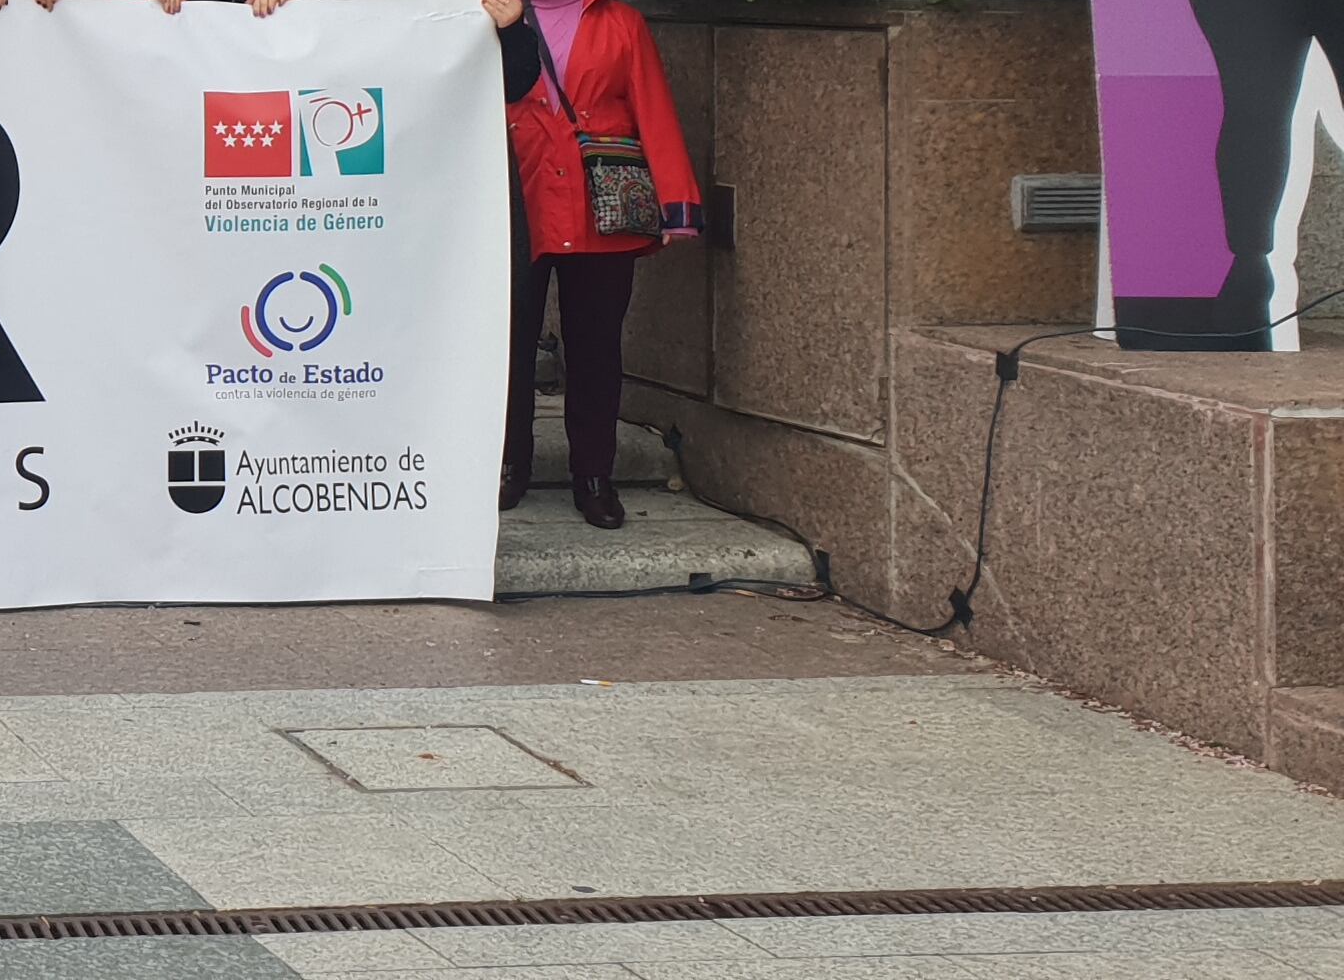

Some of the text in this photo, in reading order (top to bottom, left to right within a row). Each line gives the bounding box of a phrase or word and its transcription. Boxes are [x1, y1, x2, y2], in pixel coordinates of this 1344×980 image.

[206, 185, 294, 197] Punto Municipal
[205, 197, 377, 210] del Observatorio Regional de la
[205, 213, 383, 231] Violencia de Género
[206, 362, 383, 383] Pacto de Estado
[216, 388, 376, 401] contra la violencia de género
[236, 446, 424, 484] Ayuntamiento de
[237, 481, 427, 514] ALCOBENDAS
